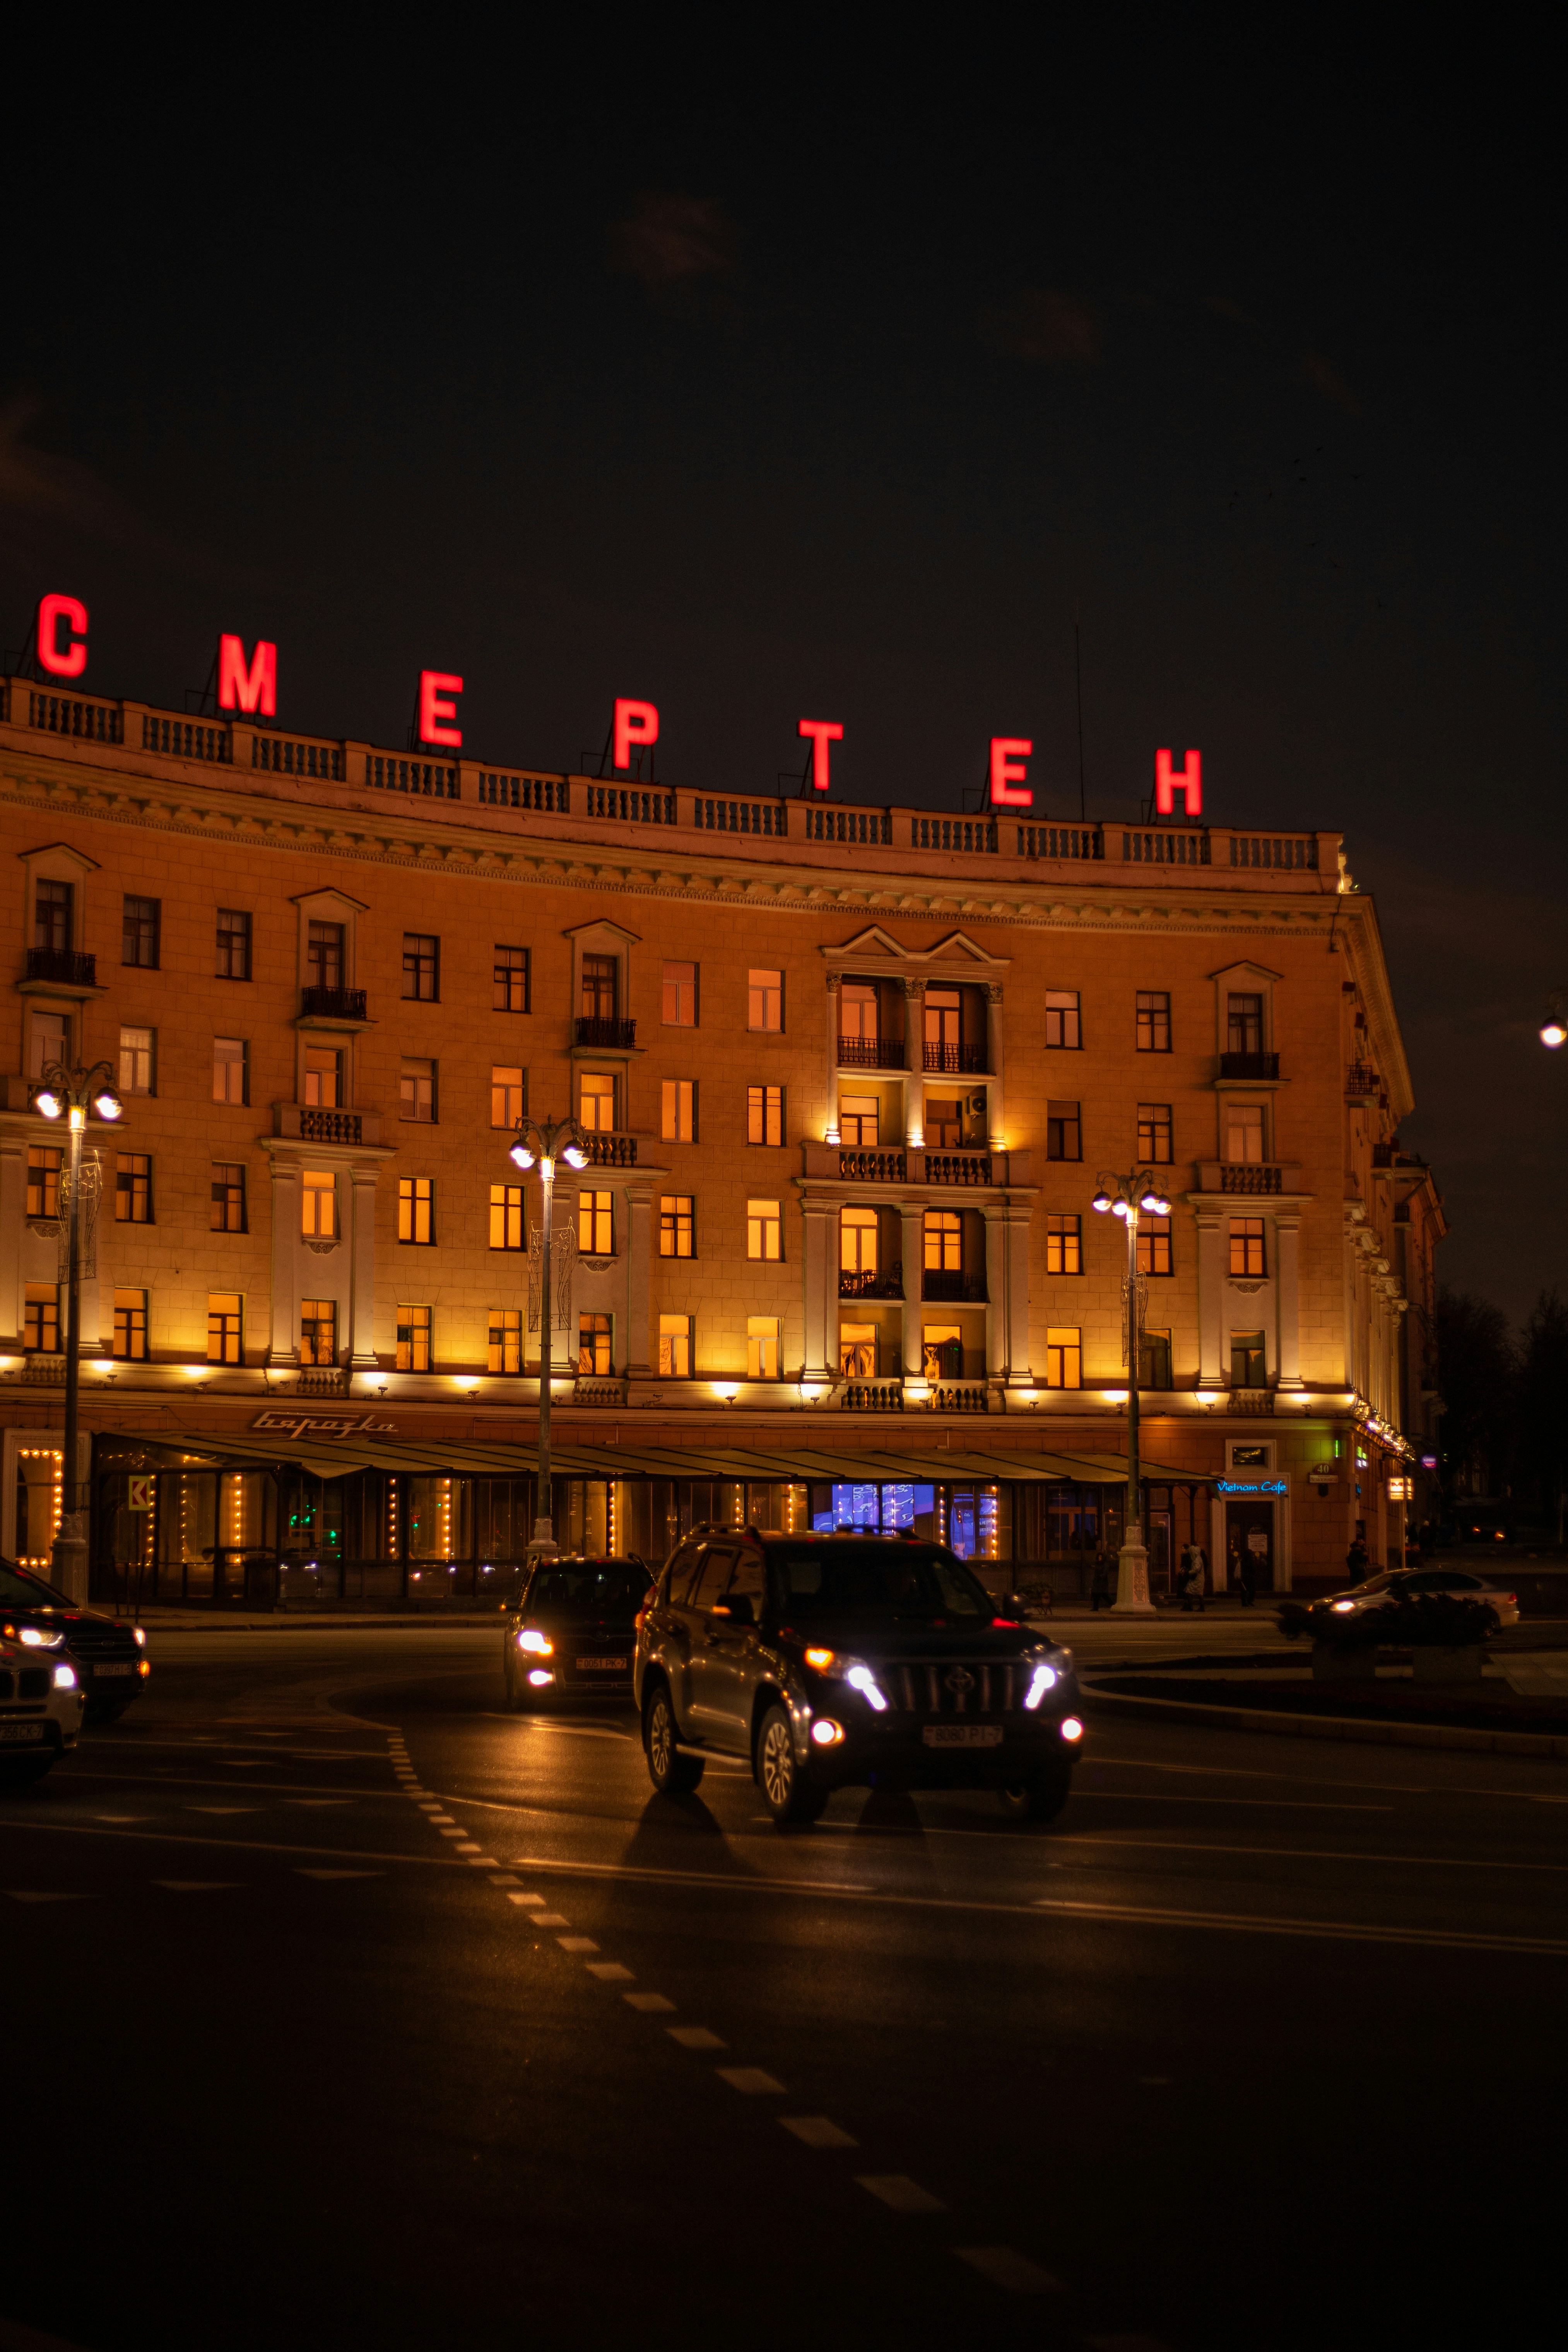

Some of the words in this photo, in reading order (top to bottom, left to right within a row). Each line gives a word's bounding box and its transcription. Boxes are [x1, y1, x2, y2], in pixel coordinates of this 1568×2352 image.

[1317, 1465, 1329, 1473] 40
[1217, 1481, 1258, 1491] Vietnam
[1261, 1480, 1286, 1494] Cafe
[584, 1659, 602, 1668] 0051
[606, 1659, 626, 1668] PK-7
